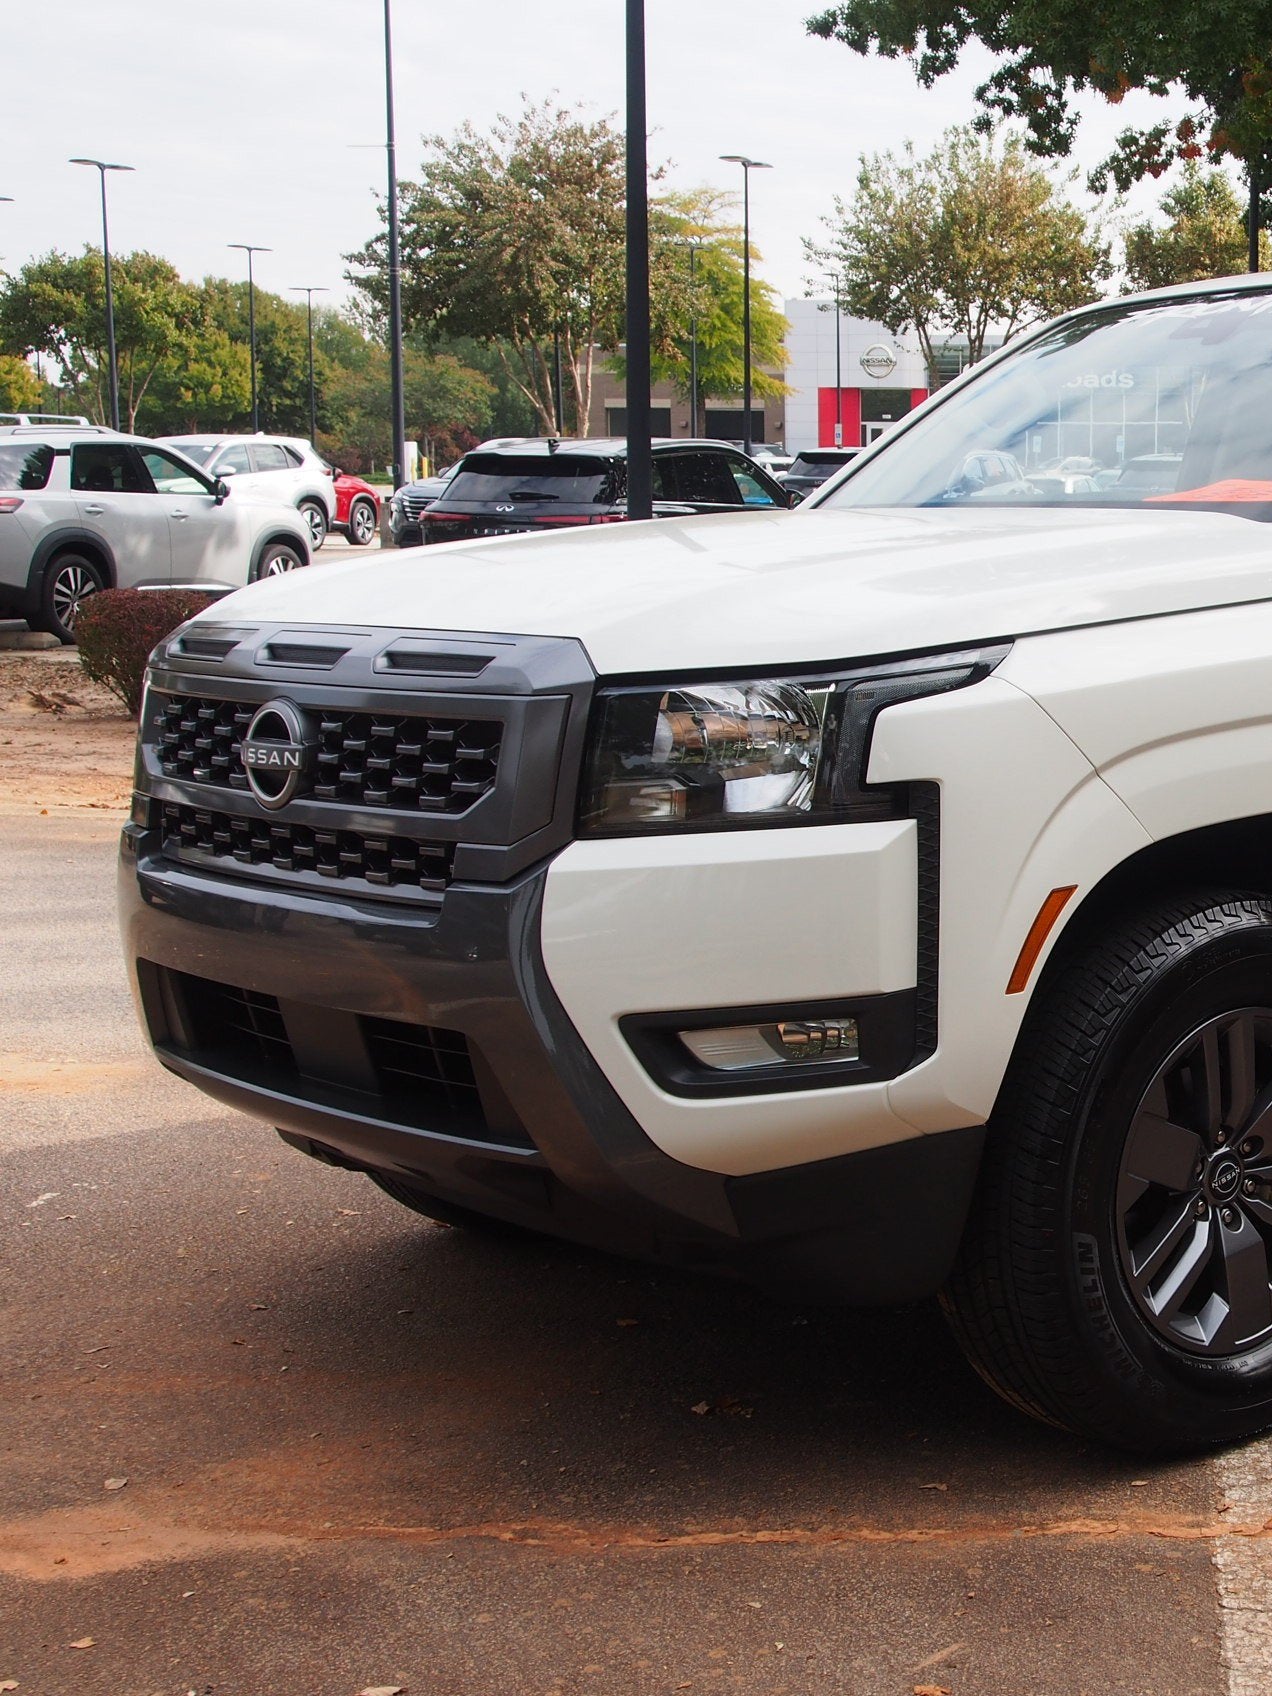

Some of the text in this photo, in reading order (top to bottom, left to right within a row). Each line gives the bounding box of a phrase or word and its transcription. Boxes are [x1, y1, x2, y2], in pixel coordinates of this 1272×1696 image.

[862, 357, 893, 365] NISSAN
[243, 747, 299, 767] ISSAN
[1211, 1166, 1241, 1188] NISSAN
